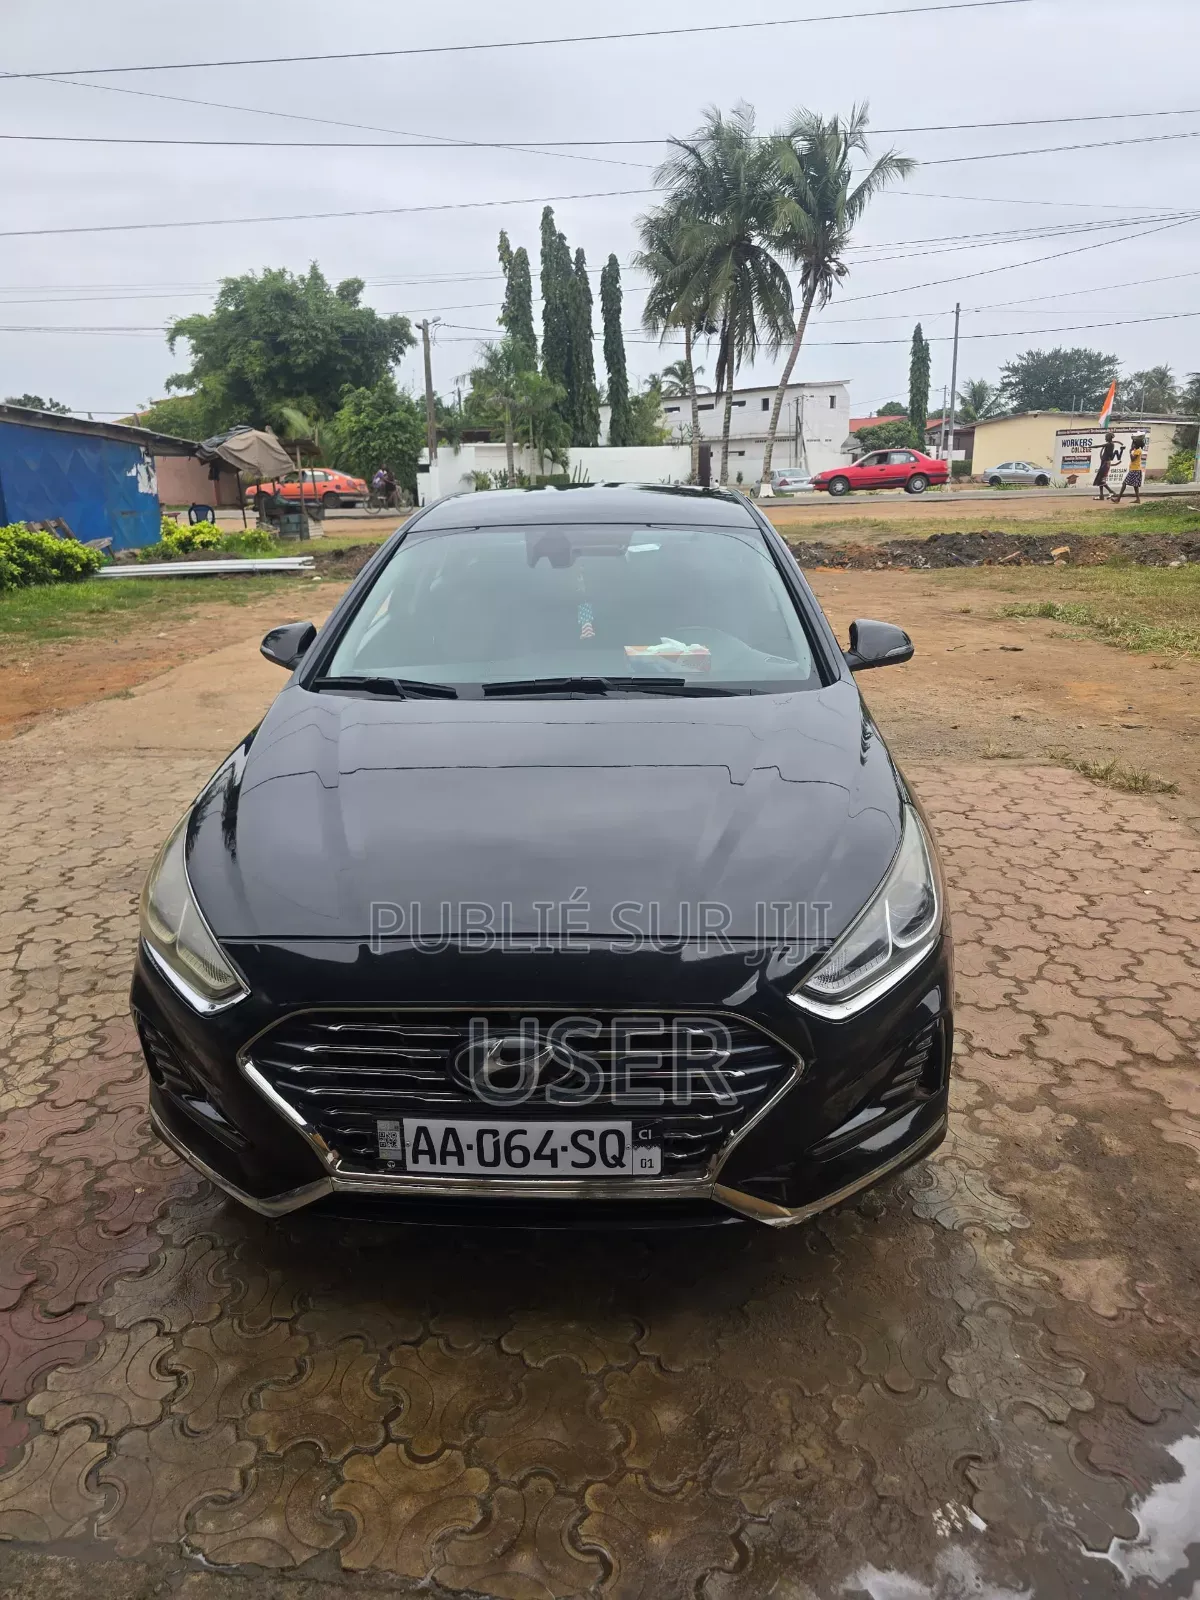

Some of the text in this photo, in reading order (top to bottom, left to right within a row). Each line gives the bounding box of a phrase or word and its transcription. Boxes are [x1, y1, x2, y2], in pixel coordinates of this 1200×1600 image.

[1061, 438, 1093, 447] WORKERS
[638, 1129, 652, 1140] CI
[640, 1158, 654, 1169] 01
